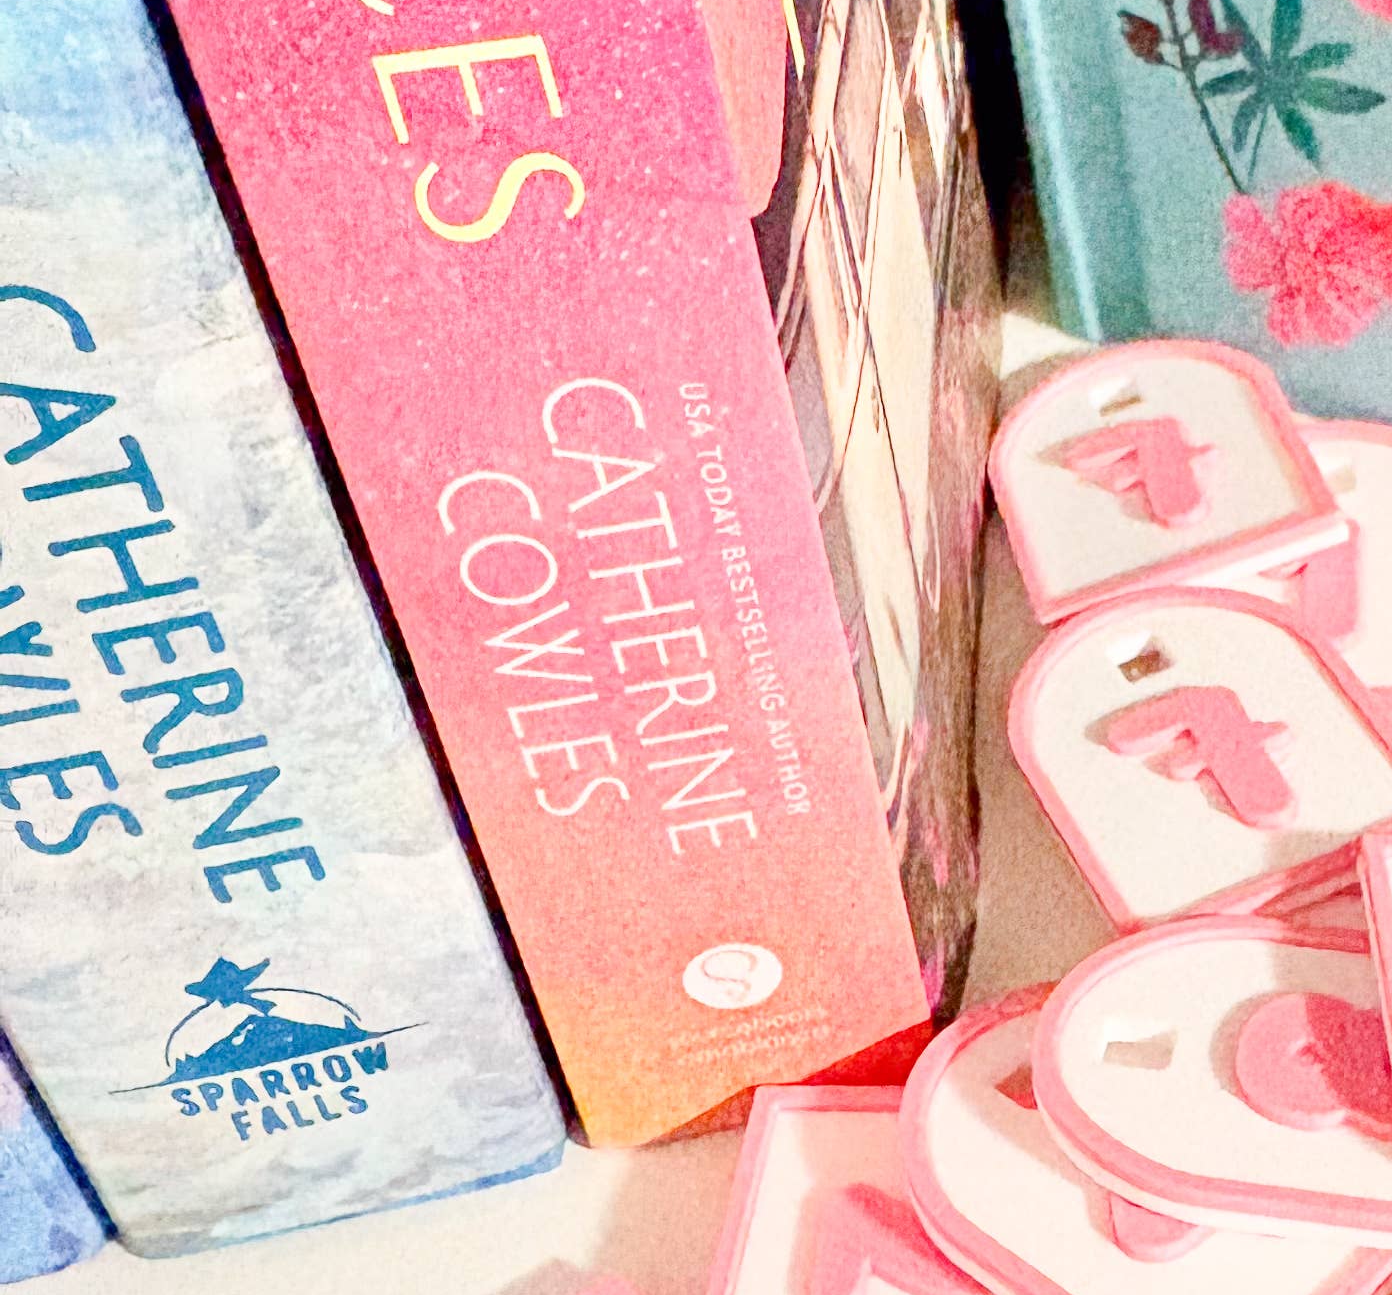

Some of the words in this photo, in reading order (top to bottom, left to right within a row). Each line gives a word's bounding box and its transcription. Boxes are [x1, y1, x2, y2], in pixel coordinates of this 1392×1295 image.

[679, 382, 715, 438] USA
[696, 445, 742, 537] TODAY
[0, 284, 327, 904] CATHERINE
[541, 377, 757, 856] CATHERINE
[721, 546, 786, 712] BESTSELLING
[437, 470, 630, 818] COWLES
[766, 718, 812, 816] AUTHOR
[172, 1042, 389, 1116] SPARROW
[231, 1086, 369, 1141] FALLS
